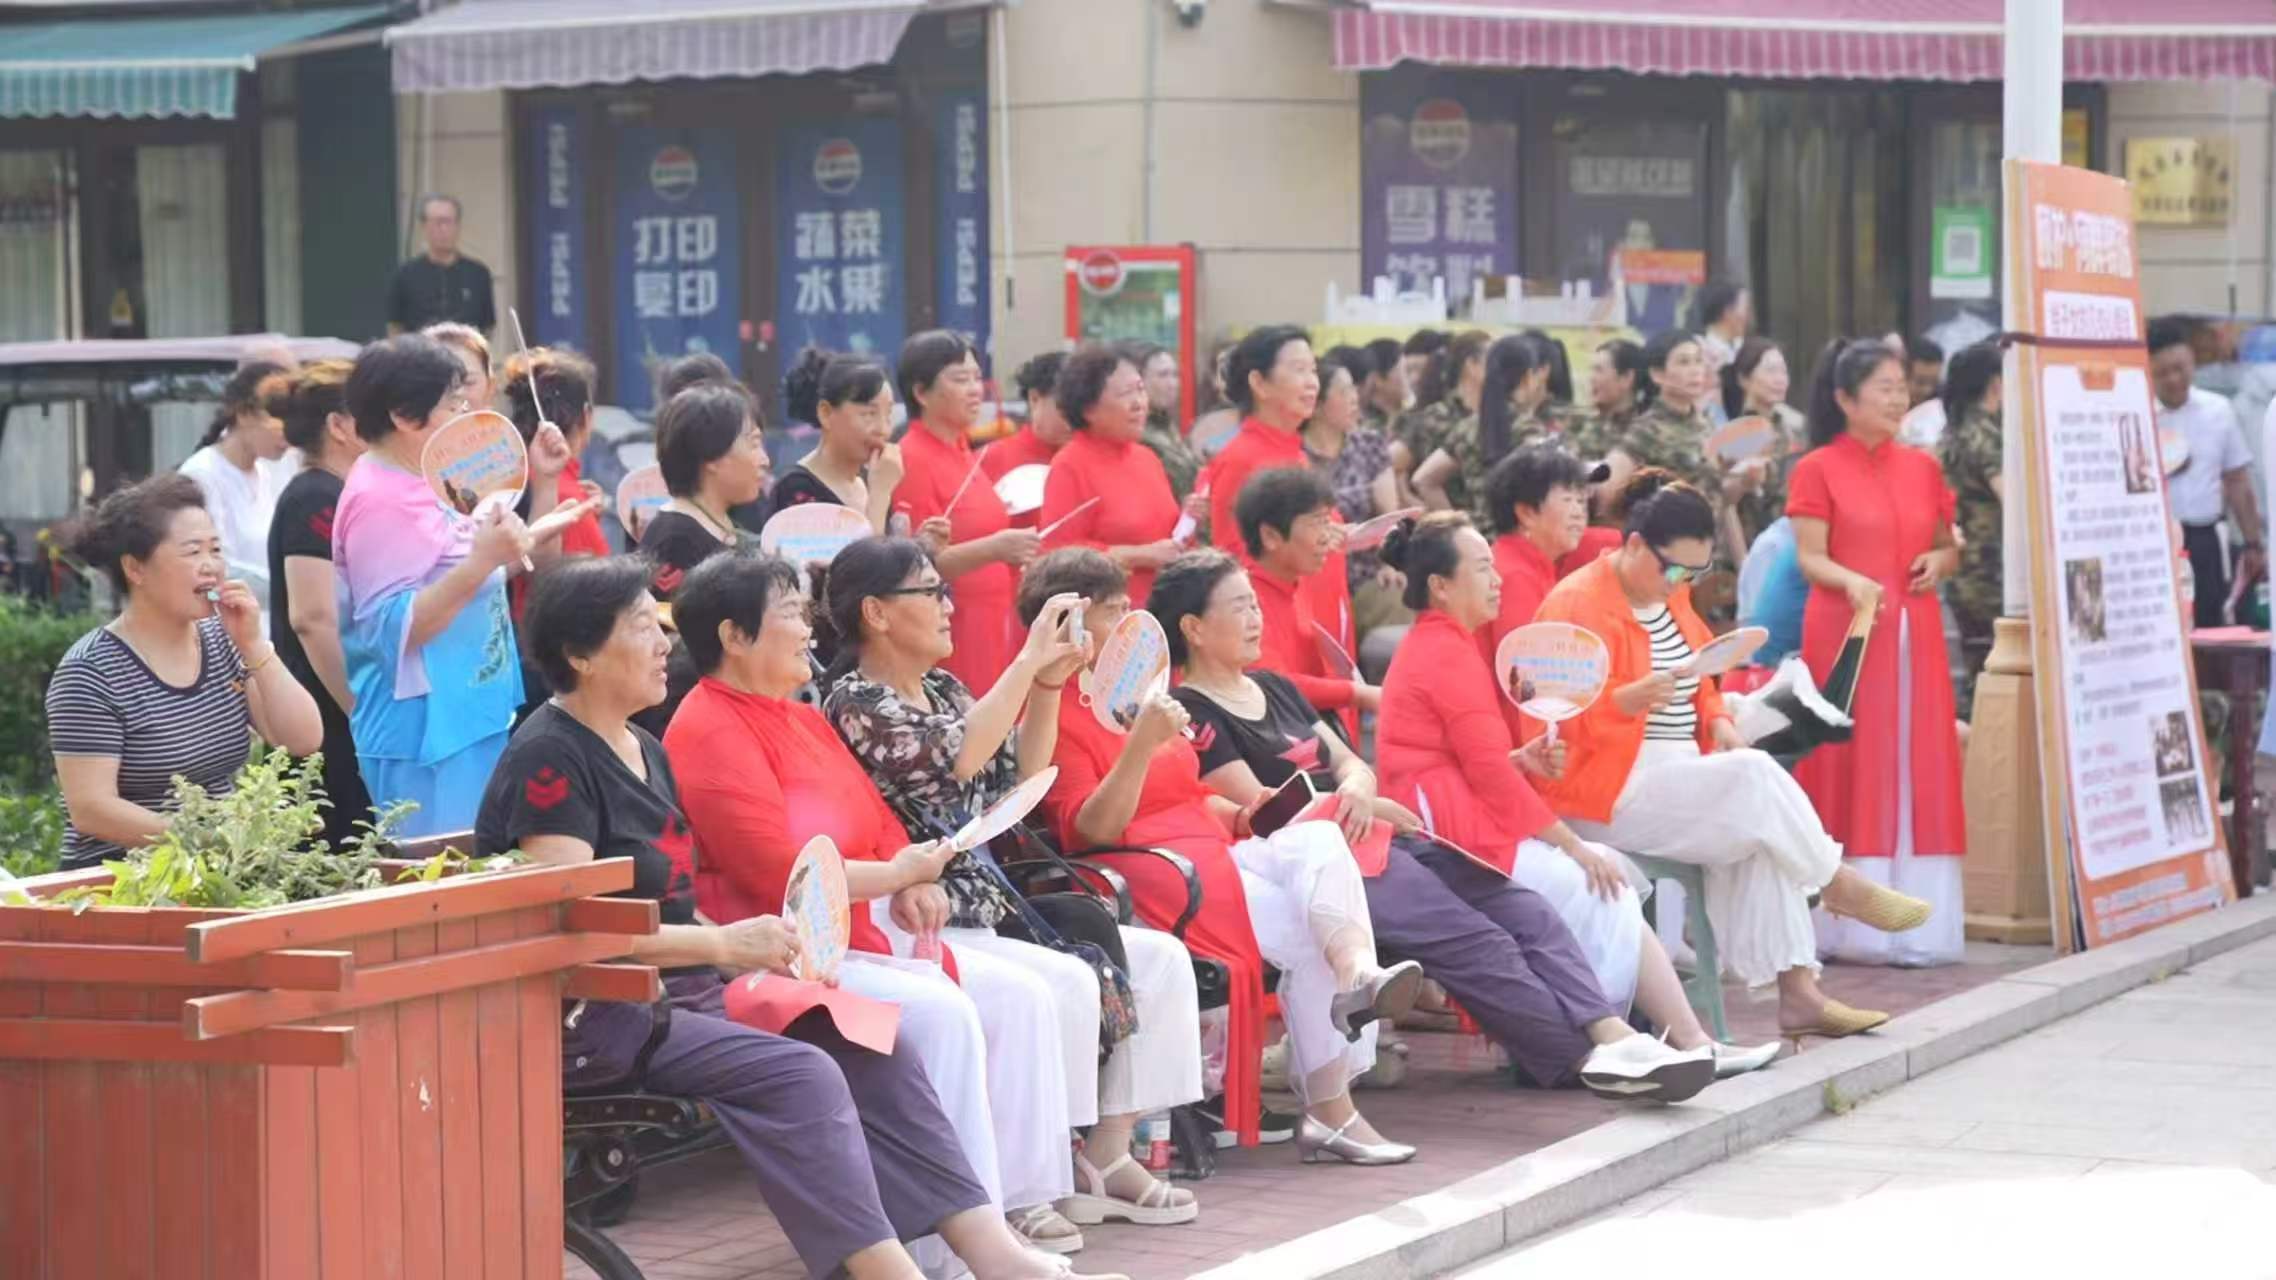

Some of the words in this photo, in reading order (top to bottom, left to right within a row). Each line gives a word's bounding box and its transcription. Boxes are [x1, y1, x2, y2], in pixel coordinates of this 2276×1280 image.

[632, 214, 719, 264] 打印
[795, 208, 882, 260] 蔬菜
[1386, 185, 1496, 243] 雪糕
[551, 232, 571, 316] PEPSI
[955, 218, 977, 306] PEPSI
[633, 269, 719, 319] 复印
[795, 264, 883, 314] 水果
